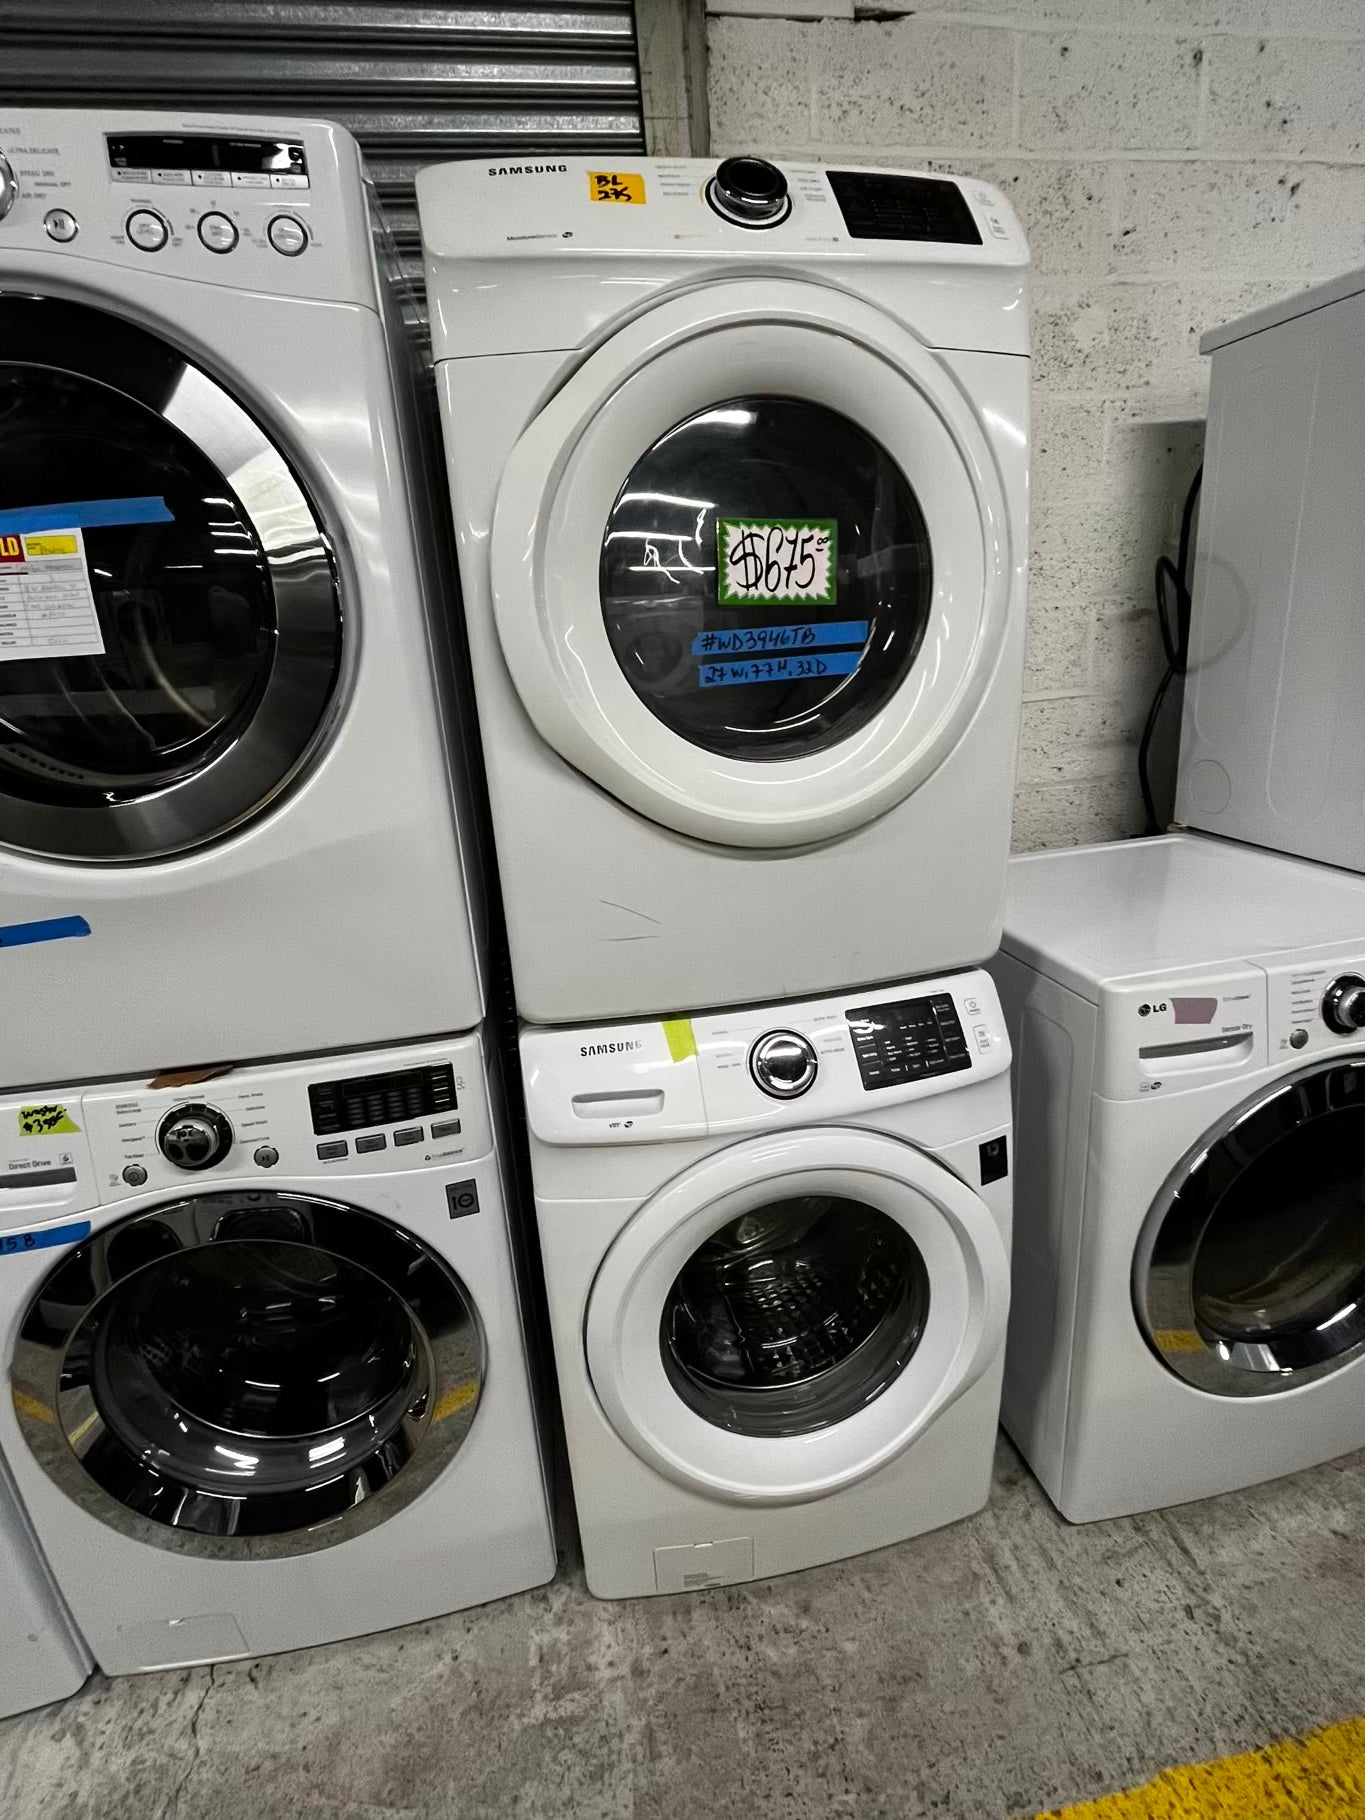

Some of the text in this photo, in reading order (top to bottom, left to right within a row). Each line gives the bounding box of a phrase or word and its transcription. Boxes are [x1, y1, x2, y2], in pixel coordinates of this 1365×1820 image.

[488, 164, 567, 176] SAMSUNG
[1153, 1003, 1167, 1013] LG
[580, 1040, 642, 1057] SAMSUNG
[32, 1160, 51, 1168] Drive
